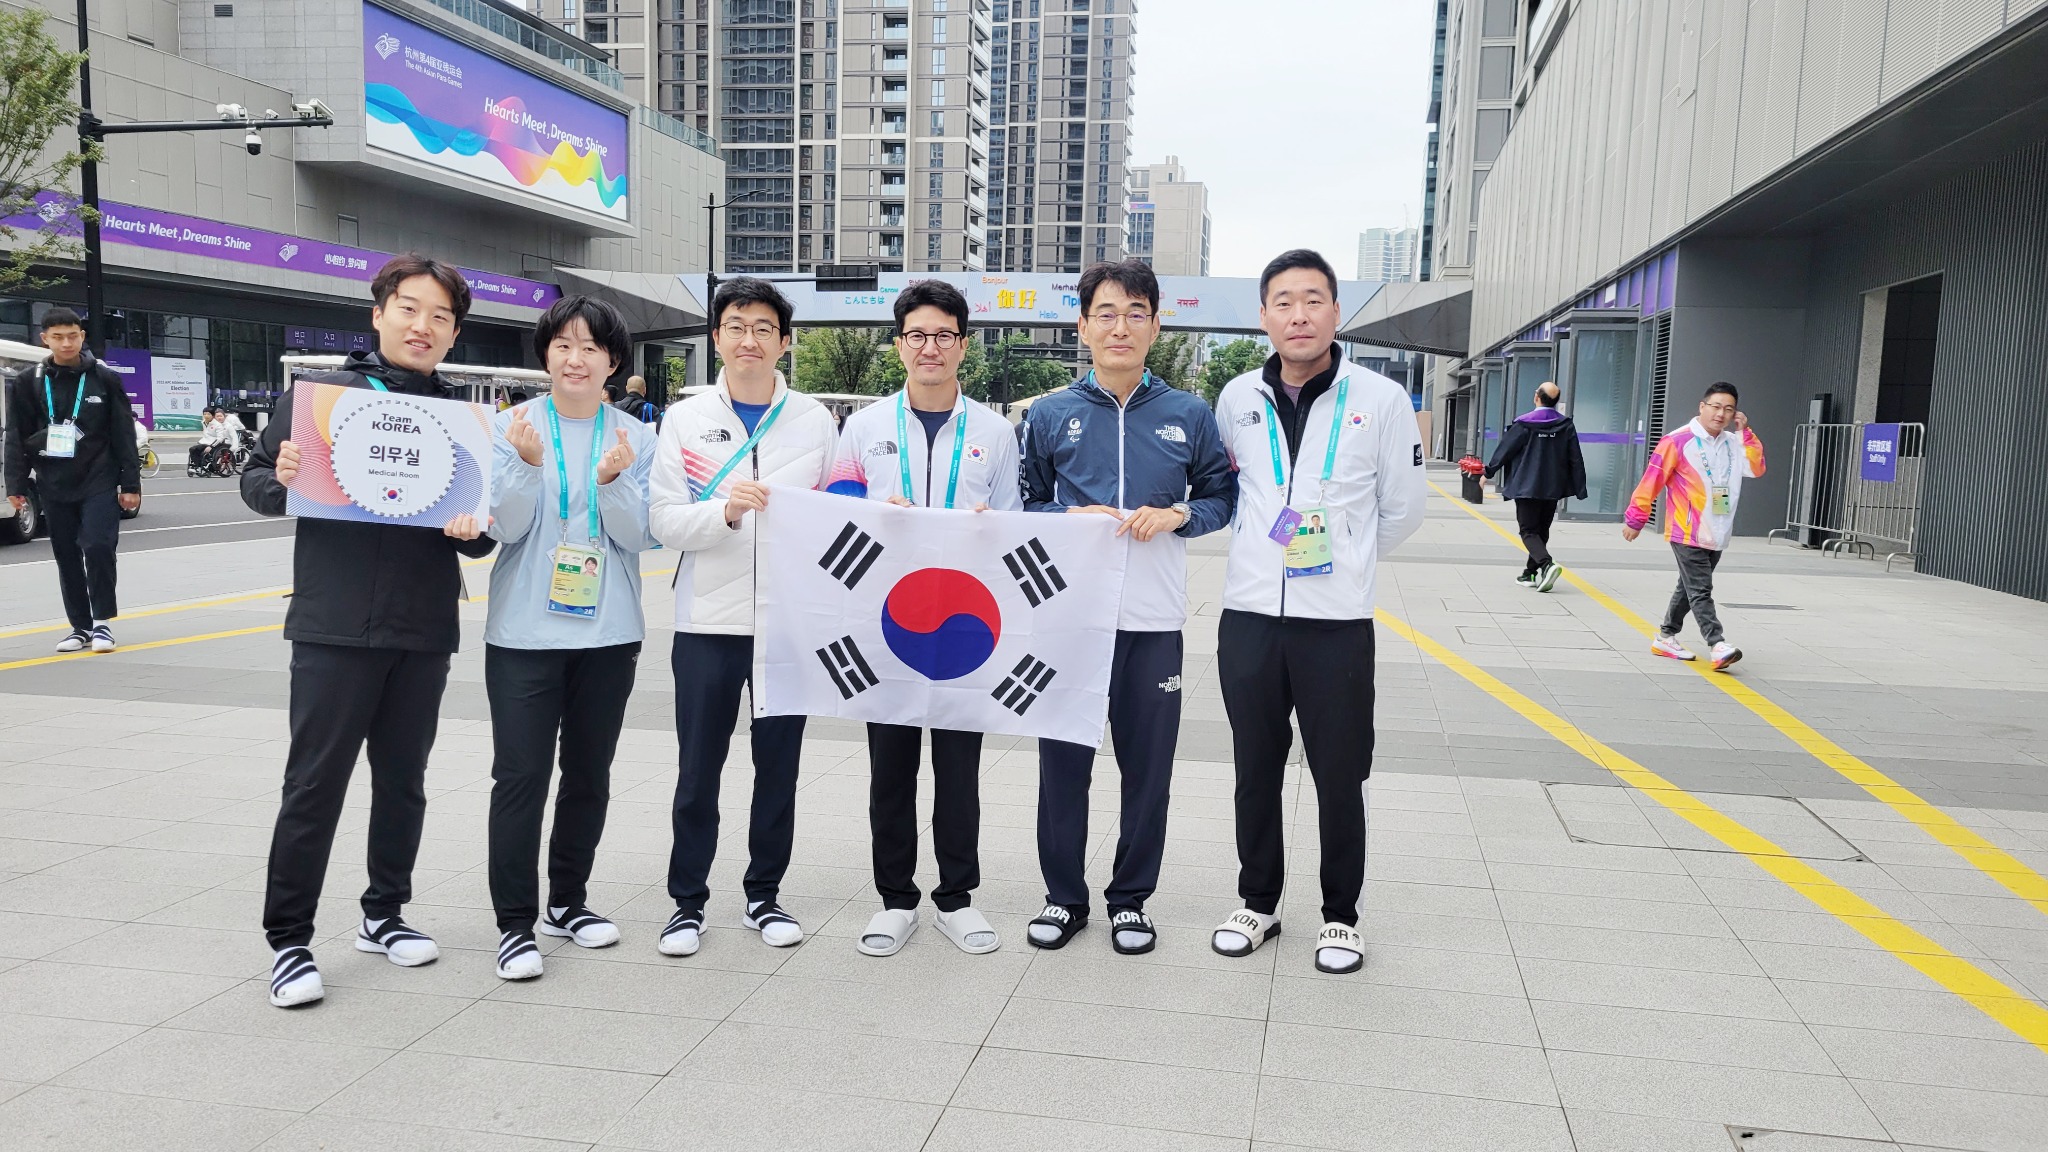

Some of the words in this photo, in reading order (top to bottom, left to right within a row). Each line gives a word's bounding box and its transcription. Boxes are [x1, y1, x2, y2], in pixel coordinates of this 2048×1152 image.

[405, 60, 414, 70] The
[415, 63, 423, 72] 4th
[424, 66, 436, 78] Asian
[436, 72, 447, 82] Para
[447, 76, 463, 88] Games
[484, 97, 519, 124] Hearts
[551, 124, 583, 148] Dreams
[584, 137, 608, 157] Shine
[105, 215, 146, 233] Hearts
[183, 228, 222, 246] Dreams
[224, 235, 251, 251] Shine
[982, 276, 1008, 285] Bonjour
[478, 280, 500, 292] Dreams
[501, 284, 517, 295] Shine
[845, 296, 885, 304] こんにちは
[997, 289, 1037, 309] 你好
[1177, 296, 1199, 308] नमस्ते
[324, 332, 335, 340] 入口
[353, 335, 364, 343] 入口
[381, 413, 412, 424] Team
[1235, 416, 1252, 424] NORTH
[372, 421, 421, 434] KOREA
[369, 444, 420, 466] 의무실
[368, 468, 398, 477] Medical
[399, 469, 420, 479] Room
[1042, 906, 1070, 924] KOR
[1113, 911, 1141, 927] KOR
[1231, 913, 1259, 931] KOR
[1319, 928, 1349, 941] KOR
